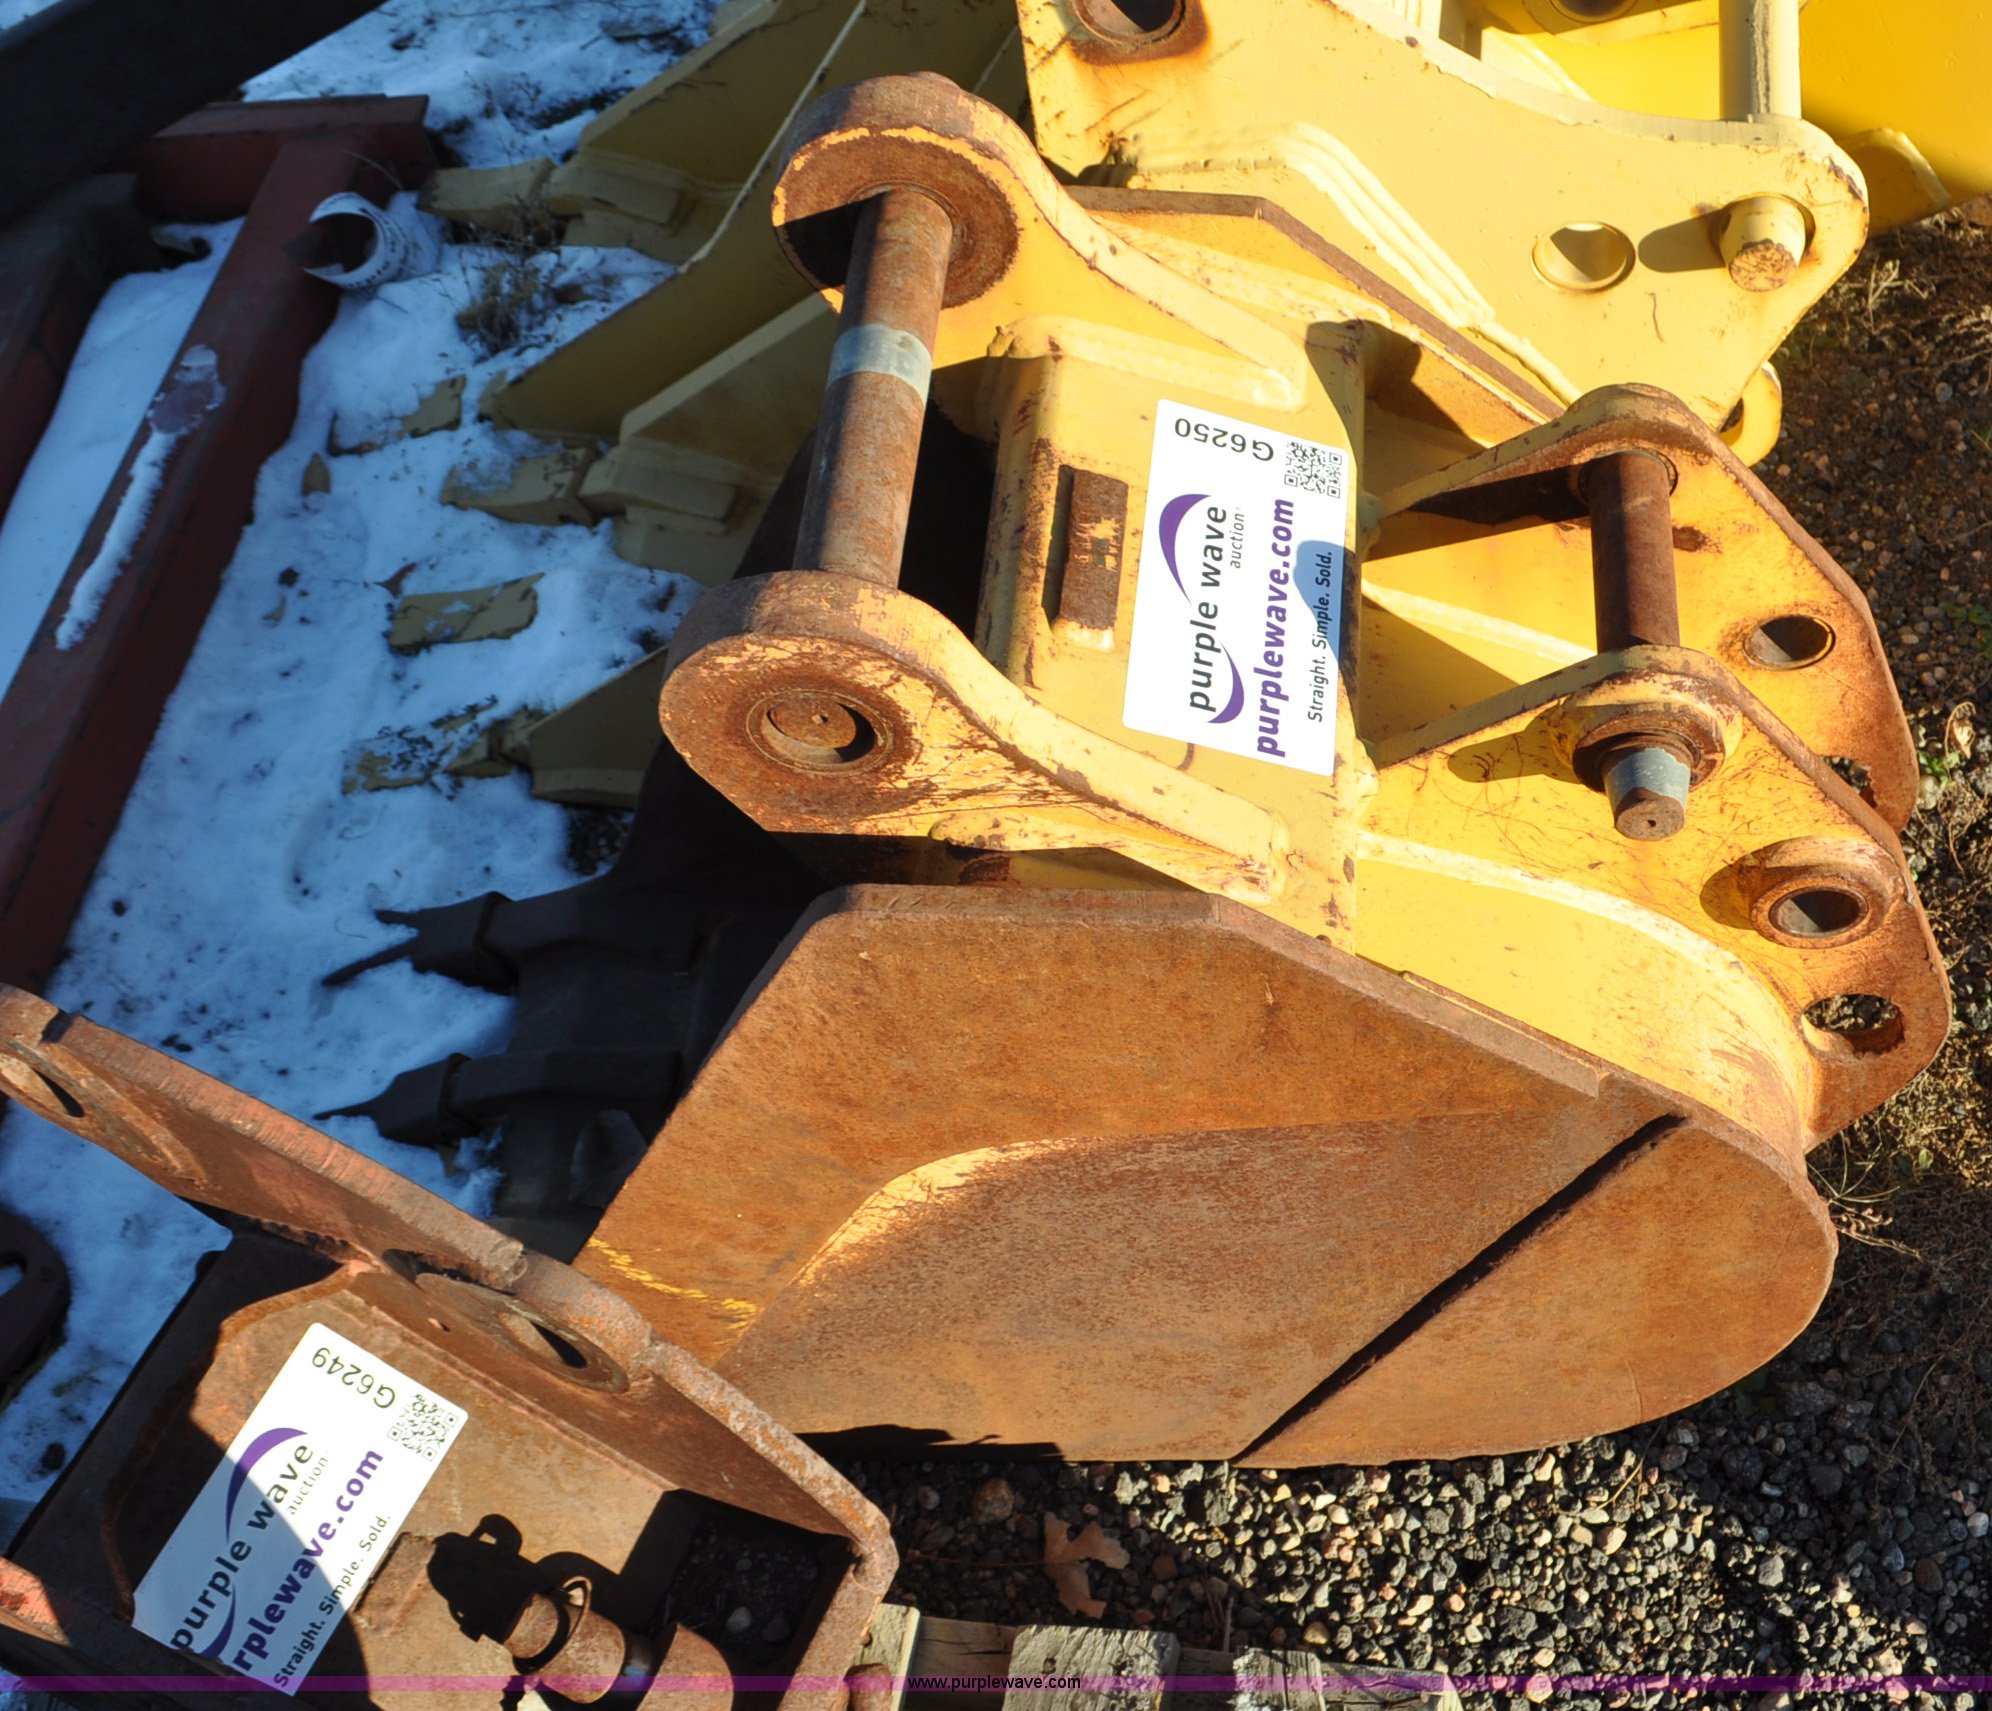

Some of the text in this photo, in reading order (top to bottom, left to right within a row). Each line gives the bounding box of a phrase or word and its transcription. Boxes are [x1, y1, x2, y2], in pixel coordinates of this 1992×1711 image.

[1175, 418, 1274, 461] G6250
[1189, 506, 1227, 712] purple wave
[1230, 512, 1245, 569] auction
[1253, 498, 1294, 757] purplewave.com
[1307, 551, 1334, 722] Straight. Simple. Sold.
[311, 1347, 396, 1409] G6249
[170, 1444, 314, 1649] purple wave
[233, 1450, 384, 1672] rplewave.com
[287, 1455, 328, 1515] auction
[274, 1515, 391, 1688] Straight. Simple. Sold.
